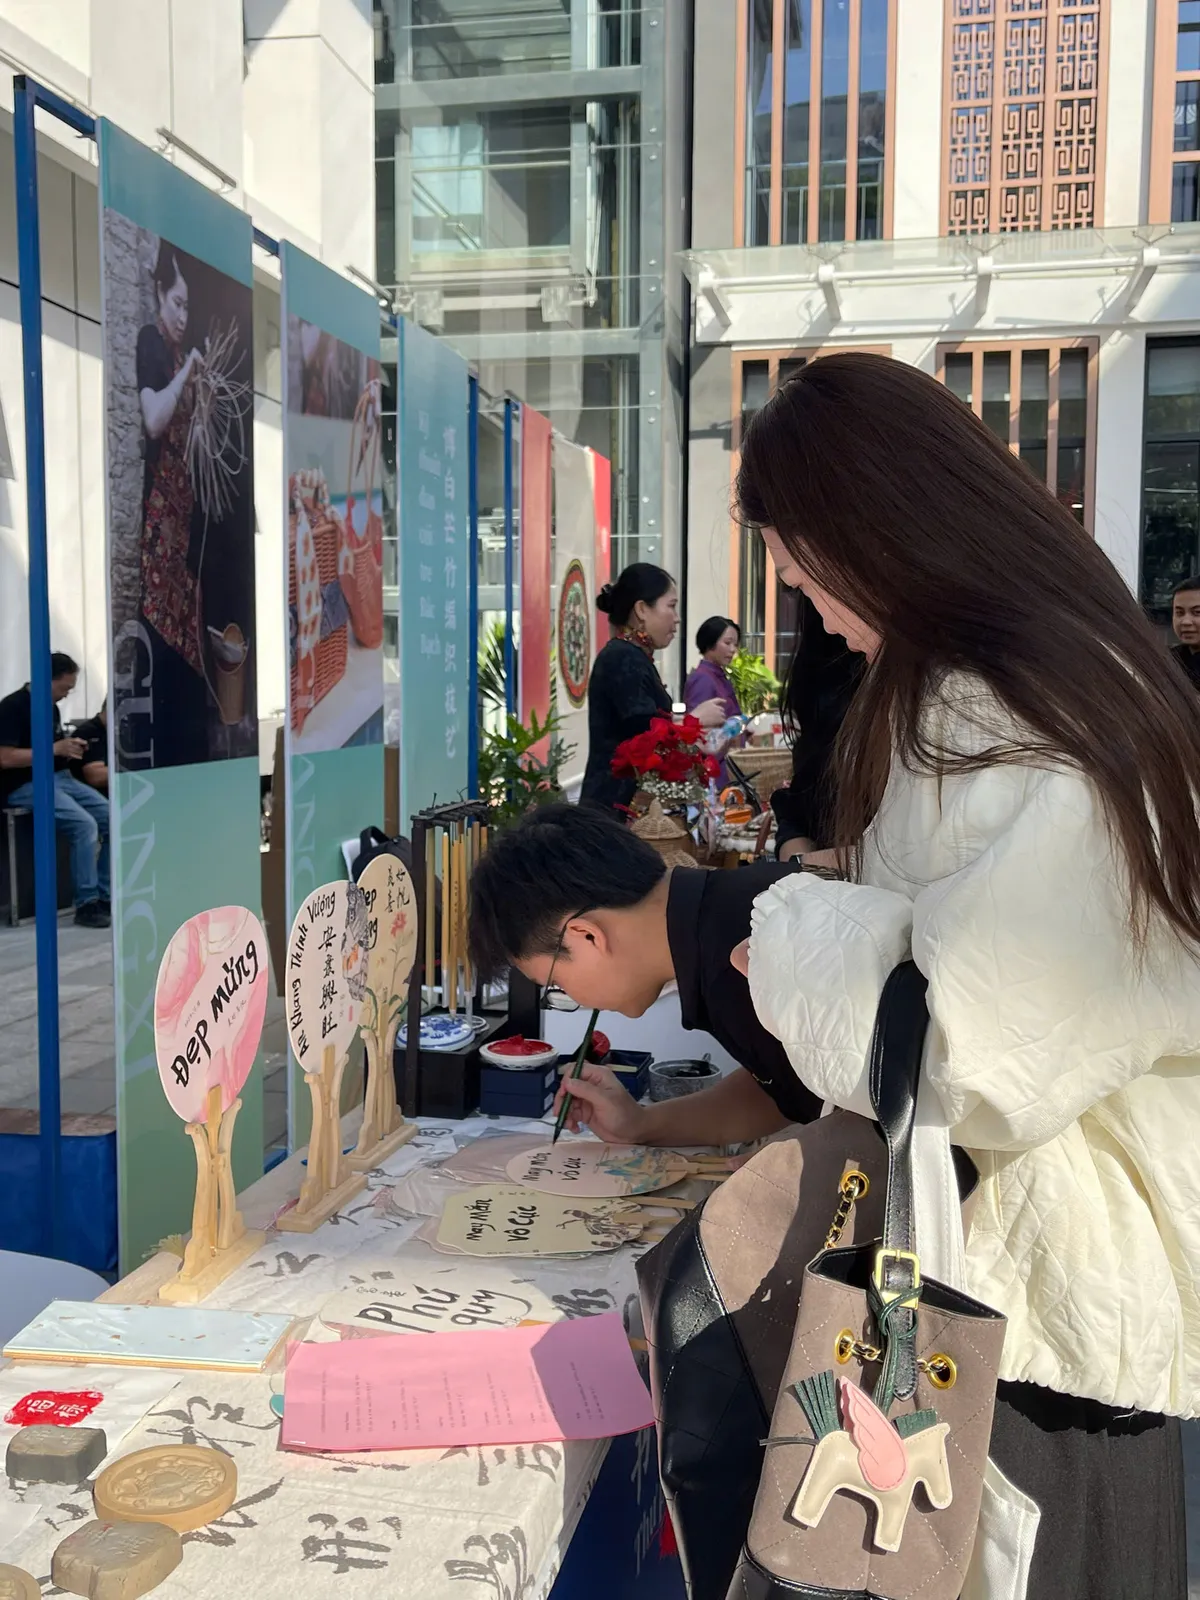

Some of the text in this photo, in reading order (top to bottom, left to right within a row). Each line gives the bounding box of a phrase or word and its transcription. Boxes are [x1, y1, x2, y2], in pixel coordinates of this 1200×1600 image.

[291, 978, 304, 1031] Khang
[170, 1019, 211, 1087] Đẹp
[297, 1030, 310, 1058] An
[466, 1223, 497, 1241] May
[354, 1283, 461, 1333] Phú
